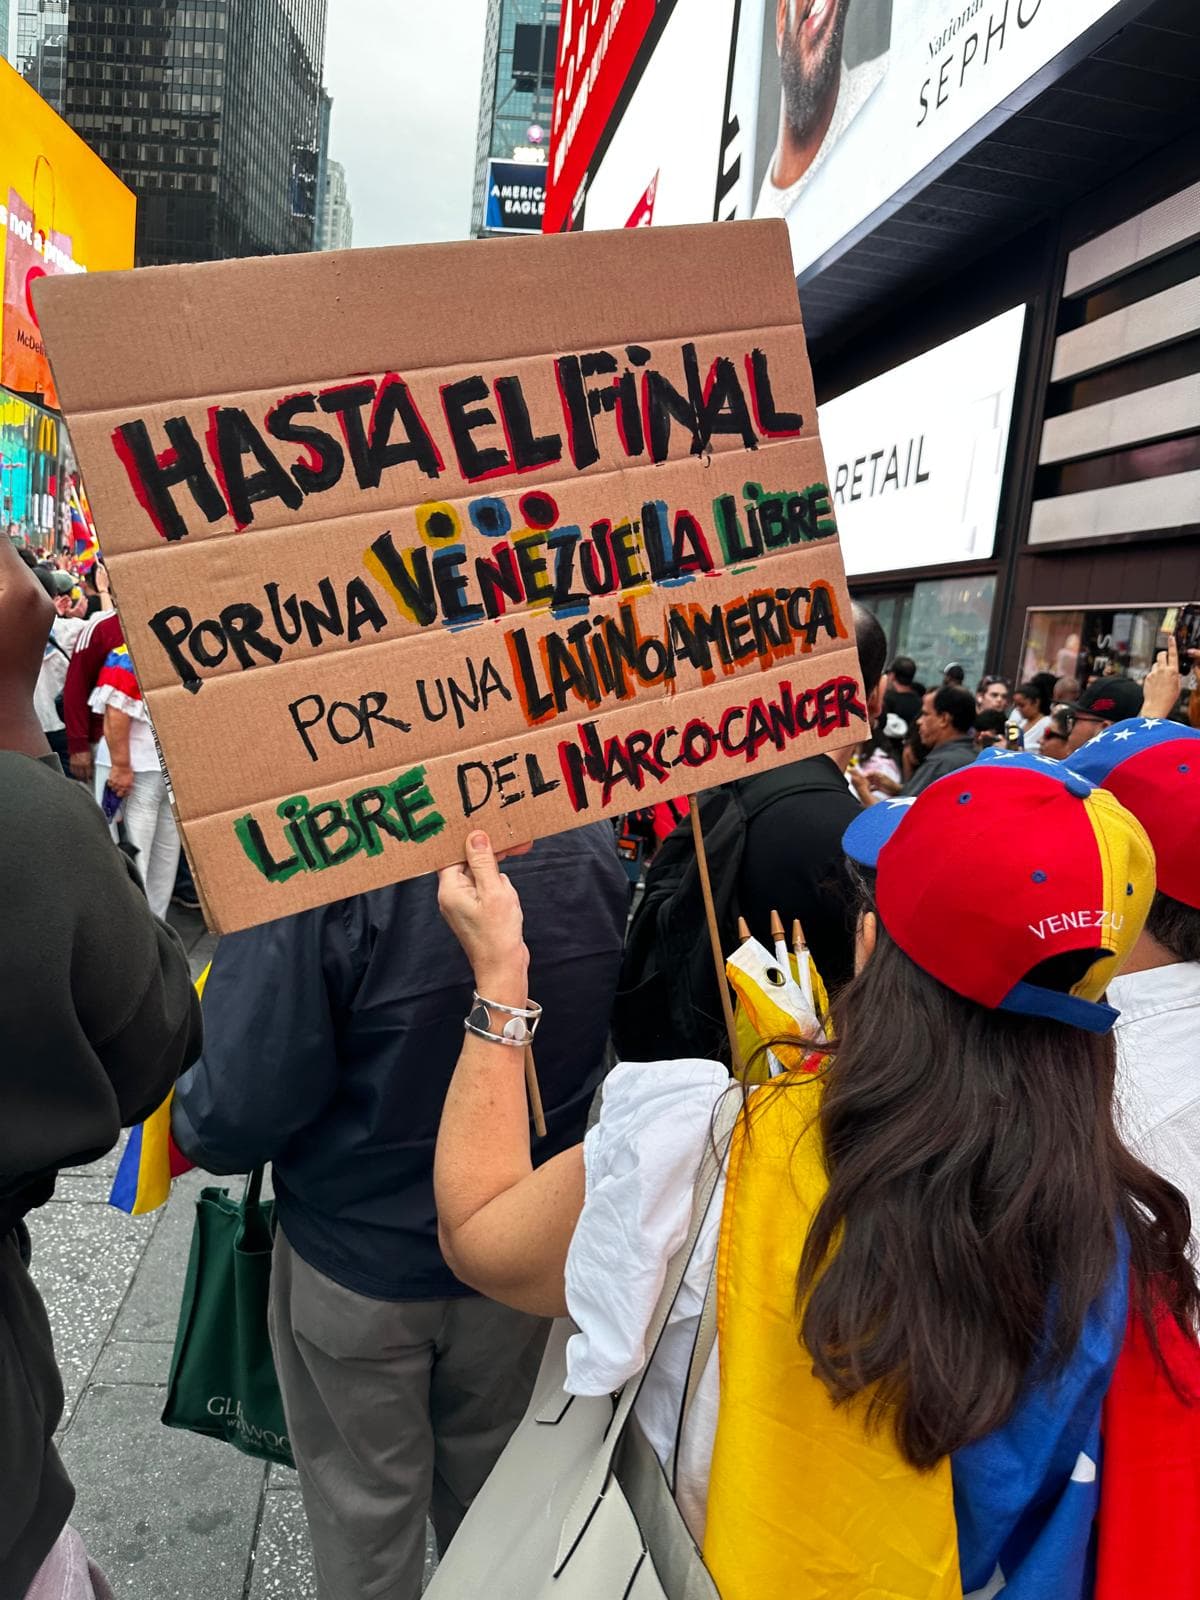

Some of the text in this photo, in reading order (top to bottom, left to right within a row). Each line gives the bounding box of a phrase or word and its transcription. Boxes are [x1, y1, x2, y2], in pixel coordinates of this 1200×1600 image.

[504, 200, 546, 216] EAGLE
[111, 371, 446, 541] HASTA
[439, 374, 563, 484] EL
[833, 434, 930, 505] RETAIL
[148, 602, 284, 695] POR
[264, 576, 388, 647] UNA
[362, 498, 720, 627] VENEZUELA
[288, 691, 412, 762] POR
[416, 656, 512, 729] UNA
[456, 753, 562, 818] DEL
[557, 675, 868, 812] NARCO-CANCER
[1027, 910, 1124, 940] VENEZU
